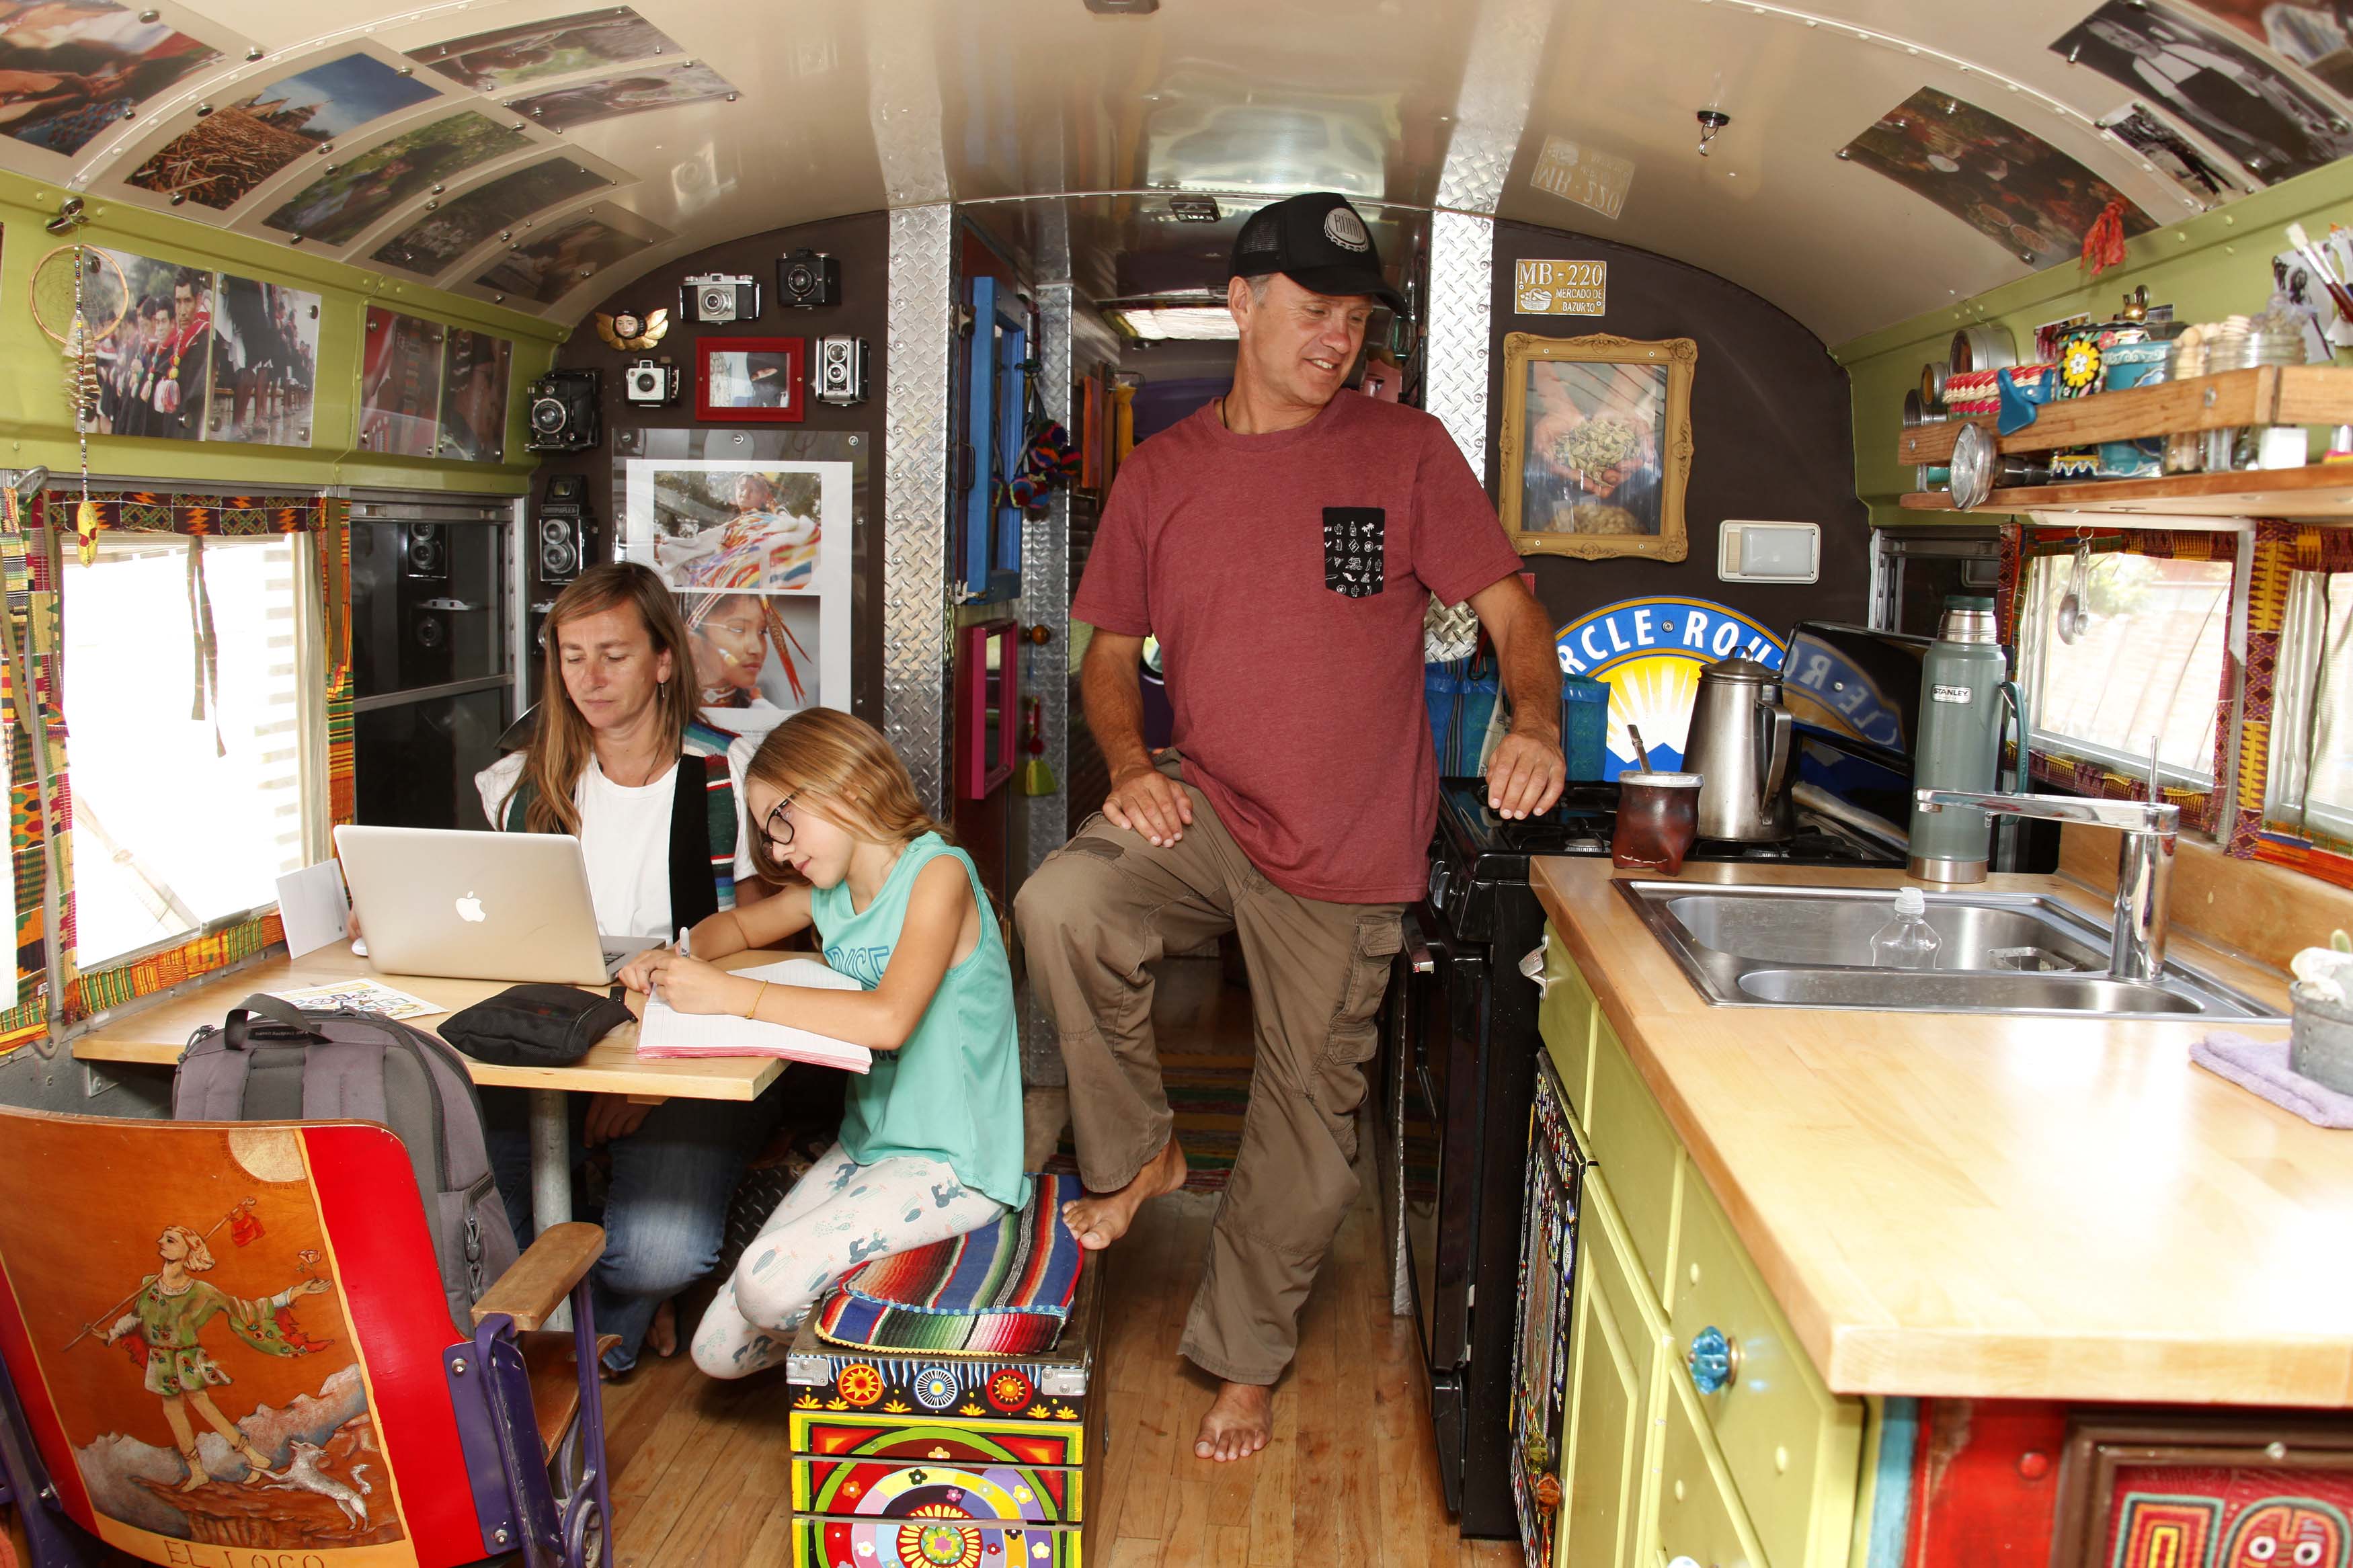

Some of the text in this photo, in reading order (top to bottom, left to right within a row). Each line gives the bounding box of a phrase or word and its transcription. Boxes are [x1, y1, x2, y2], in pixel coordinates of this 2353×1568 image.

[1556, 288, 1603, 299] MERCADO DE
[1562, 301, 1595, 313] BAZURTO
[1933, 688, 1968, 697] STANLEY
[164, 1539, 210, 1568] EL
